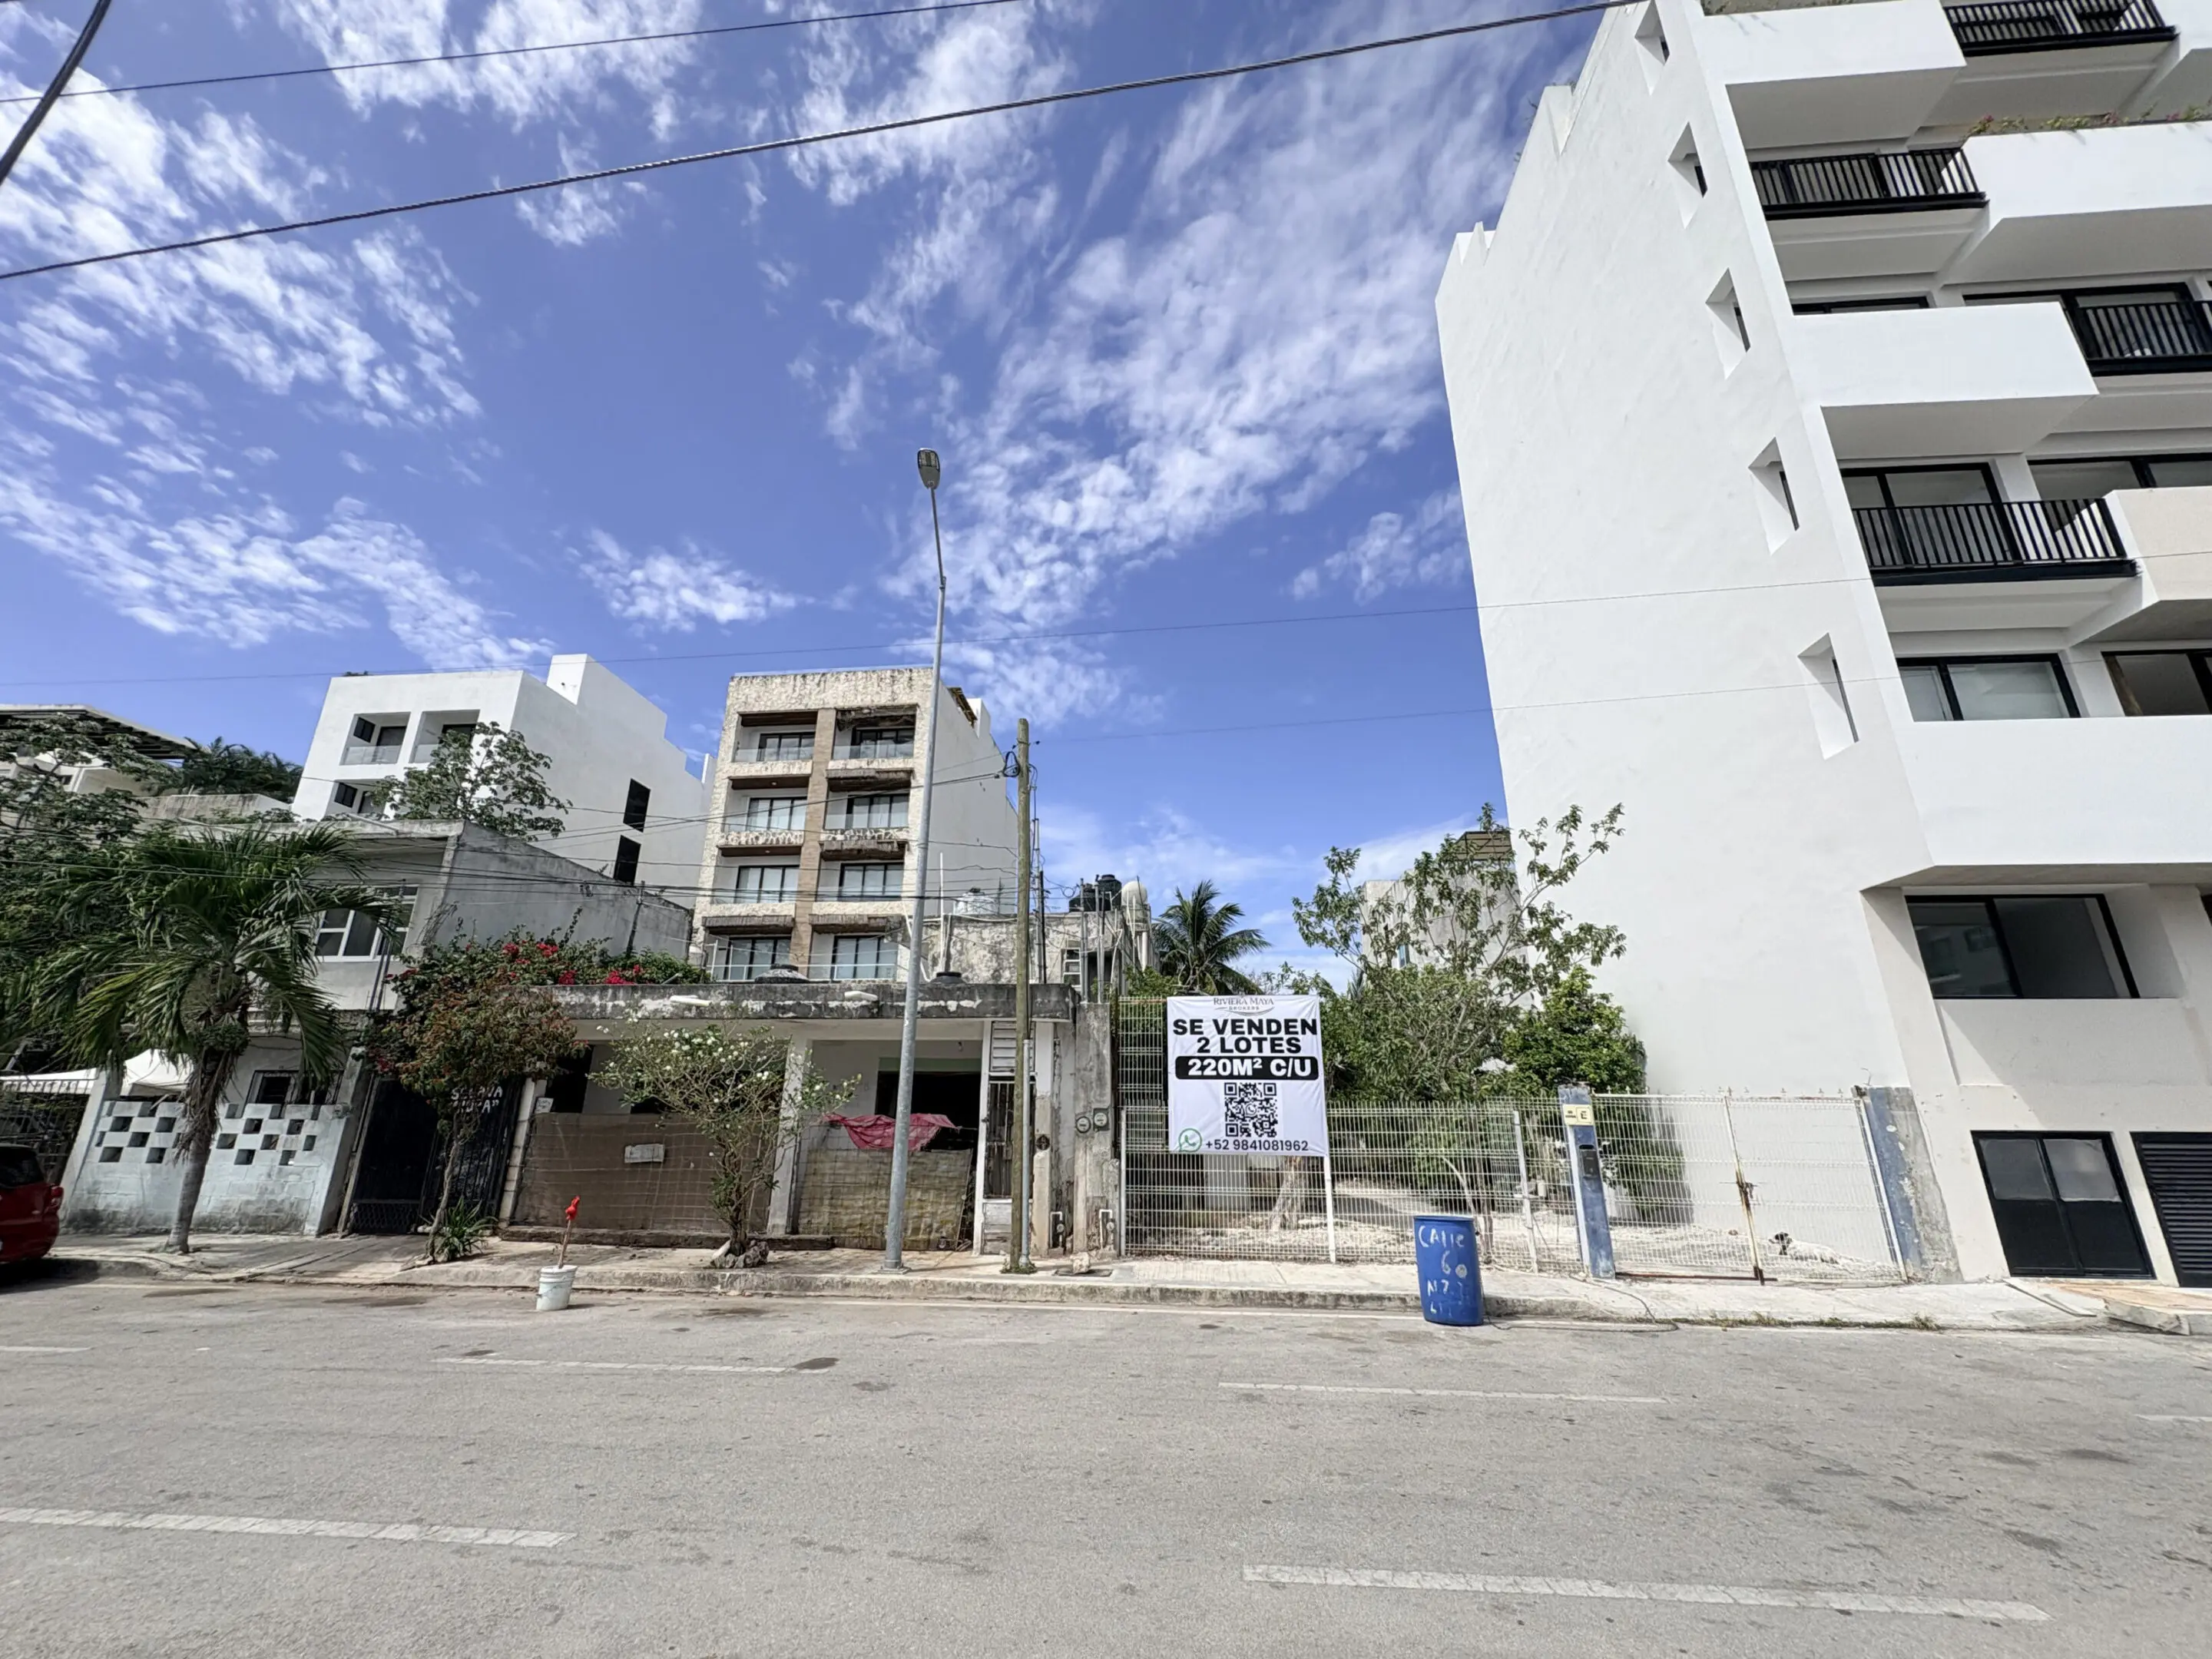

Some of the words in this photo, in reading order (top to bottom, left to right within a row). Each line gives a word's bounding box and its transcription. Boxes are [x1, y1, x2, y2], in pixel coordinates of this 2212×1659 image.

[1214, 997, 1248, 1005] RIVIERA
[1250, 997, 1274, 1005] MAYA
[1173, 1018, 1204, 1035] SE
[1212, 1018, 1317, 1035] VENDEN
[1197, 1037, 1210, 1054] 2
[1220, 1037, 1301, 1054] LOTES
[1270, 1058, 1311, 1078] C/U
[1206, 1140, 1229, 1151] +52
[1233, 1140, 1309, 1151] 9841081962
